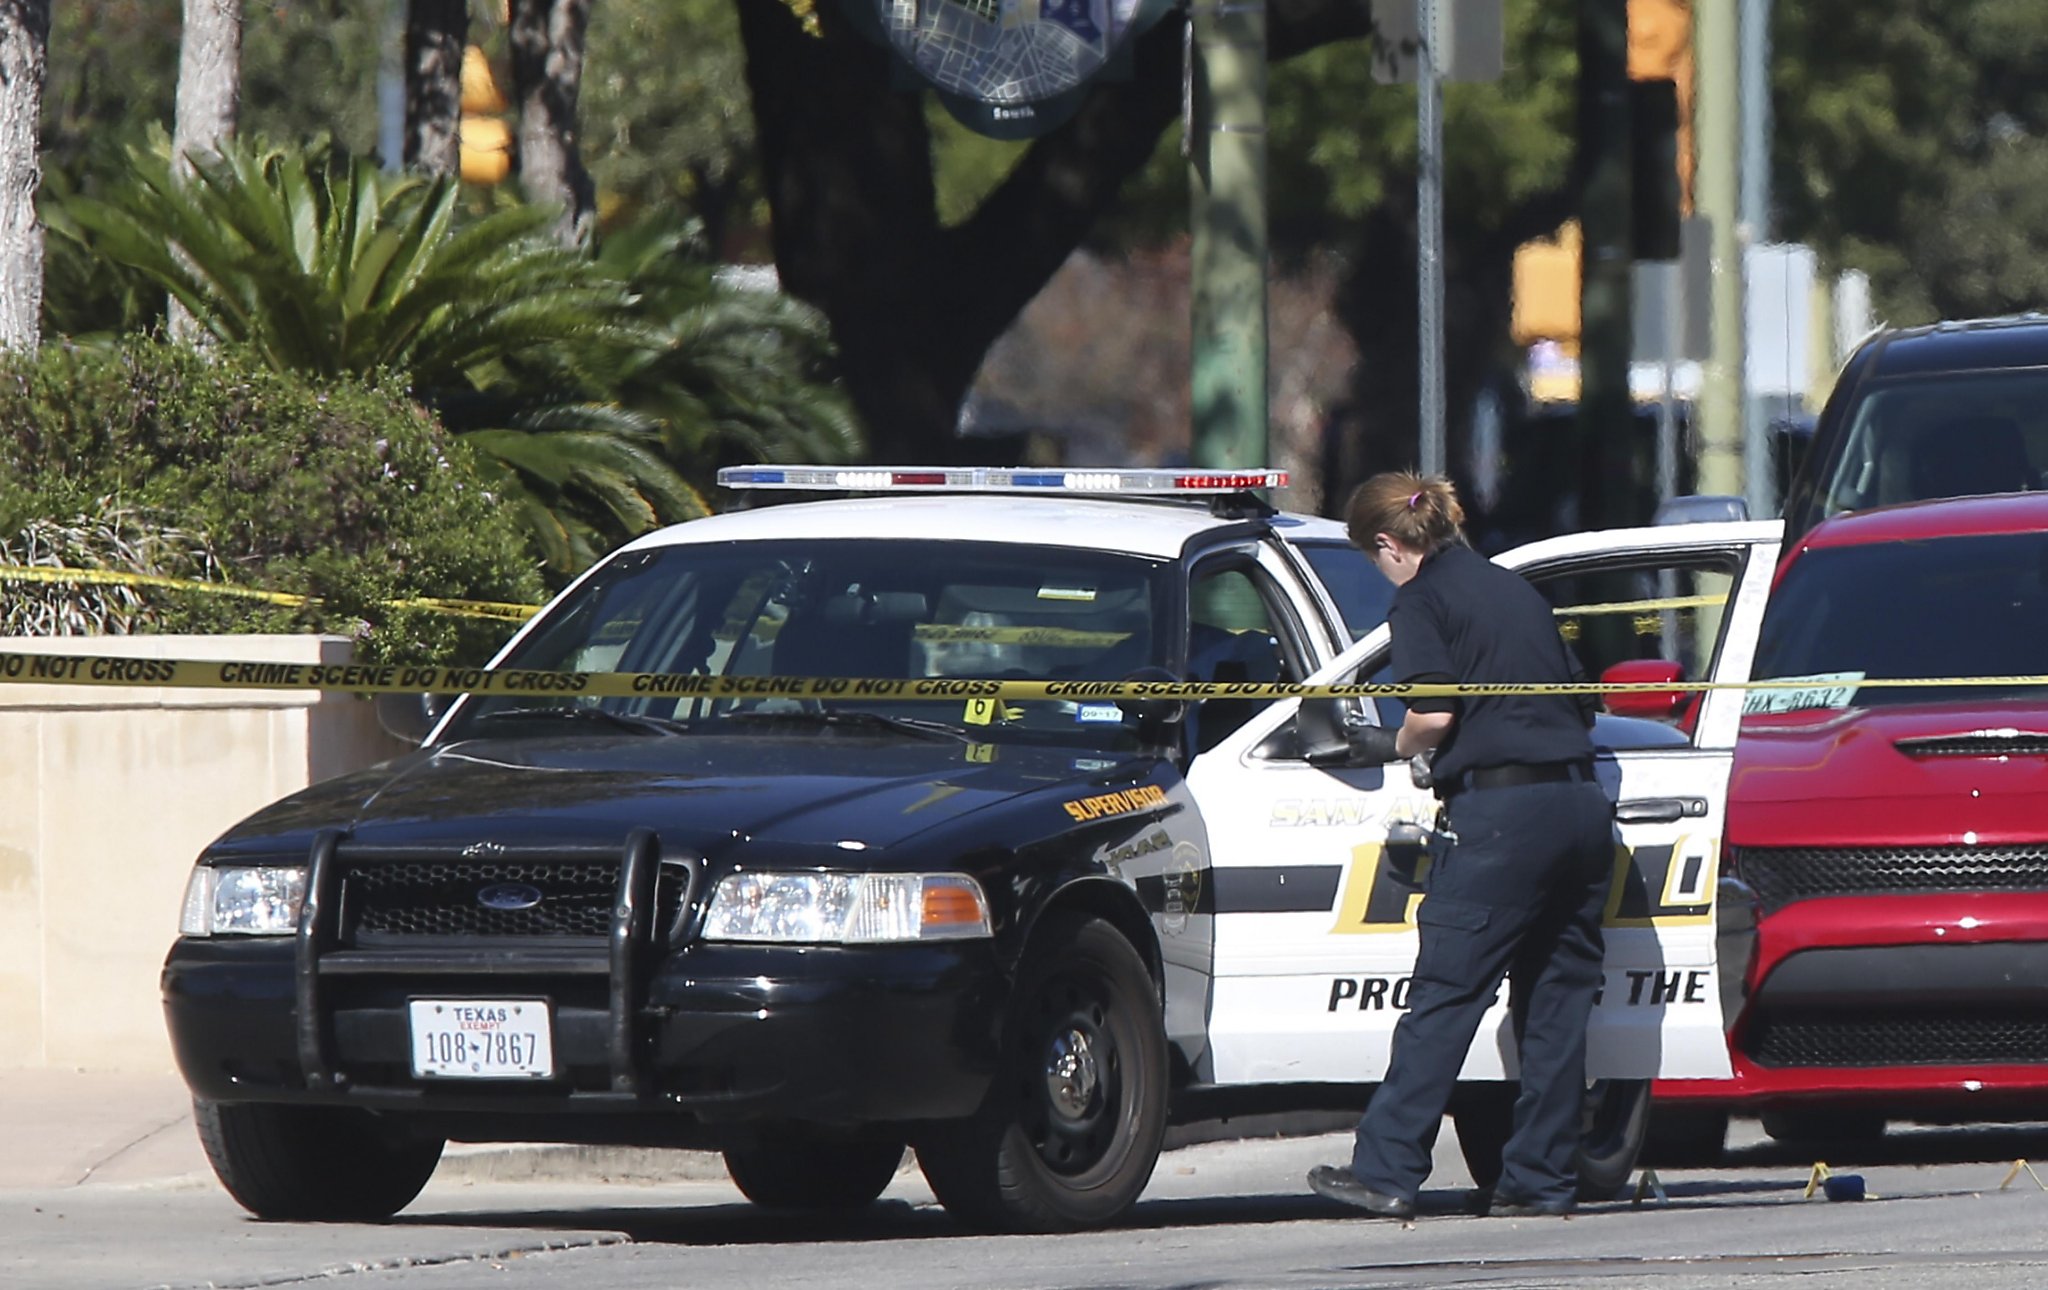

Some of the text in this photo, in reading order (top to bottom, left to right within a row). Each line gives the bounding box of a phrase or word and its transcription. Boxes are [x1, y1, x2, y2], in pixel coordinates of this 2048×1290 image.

[0, 654, 176, 681] O NOT CROSS
[220, 663, 590, 691] CRIME SCENE DO NOT CROSS
[632, 674, 1002, 695] CRIME SCENE DO NOT CROSS
[1045, 681, 1125, 695] CRIME
[1133, 682, 1216, 695] SCENE
[1224, 683, 1258, 695] DO
[1063, 784, 1169, 822] SUPERVISOR
[1270, 798, 1368, 827] SAN
[1626, 971, 1710, 1005] THE
[454, 1008, 507, 1022] TEXAS
[460, 1022, 500, 1030] EXEMPT
